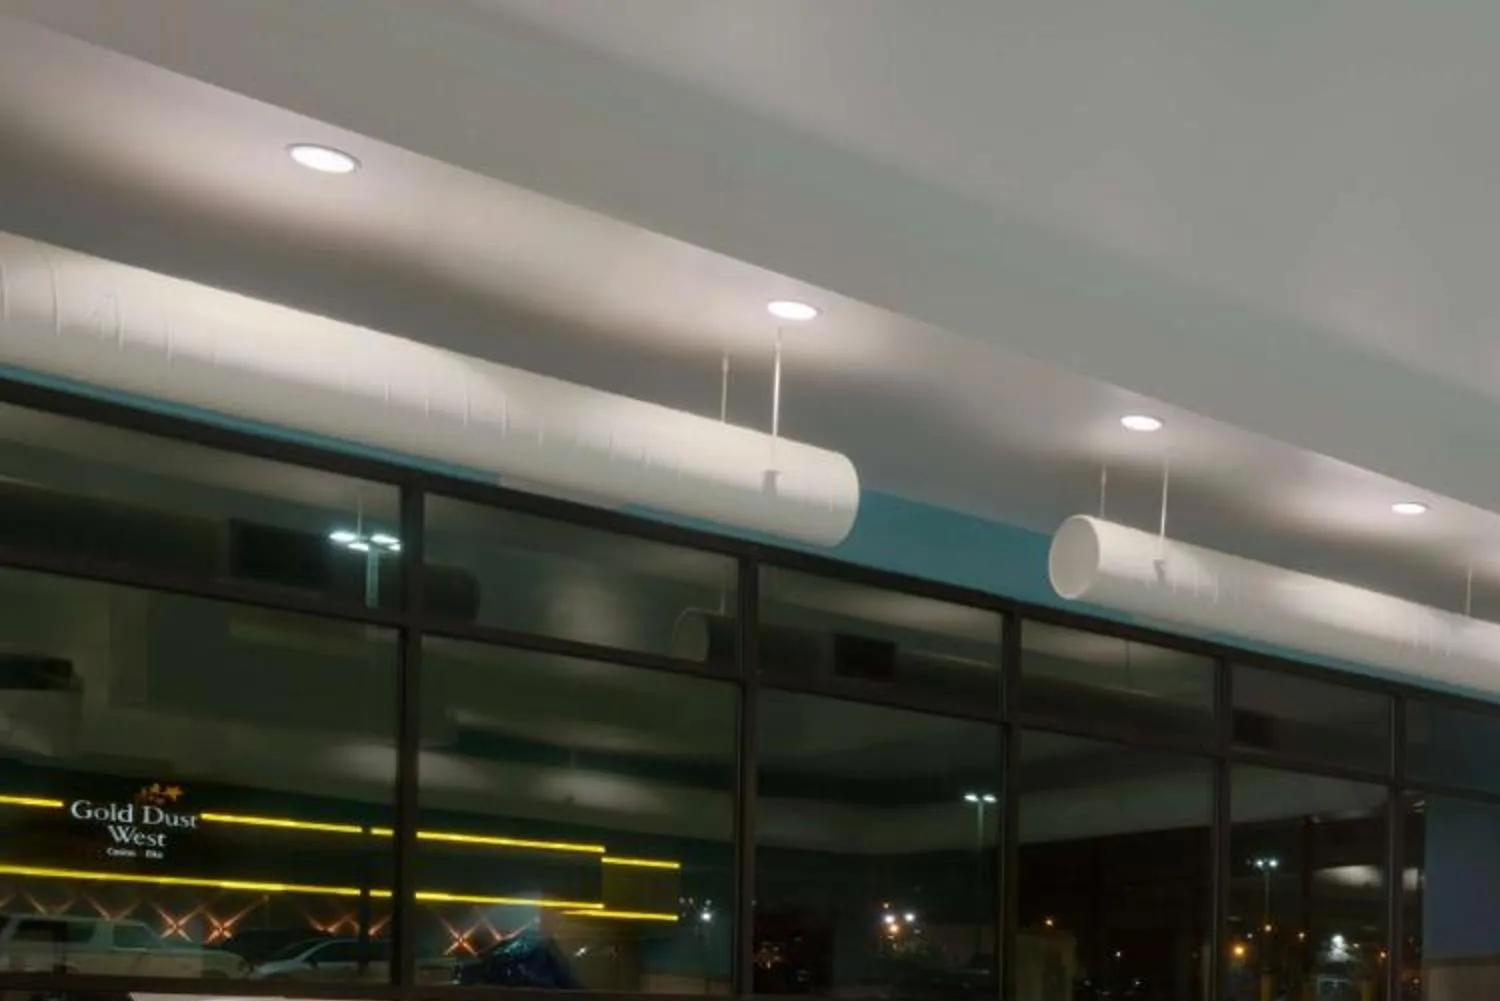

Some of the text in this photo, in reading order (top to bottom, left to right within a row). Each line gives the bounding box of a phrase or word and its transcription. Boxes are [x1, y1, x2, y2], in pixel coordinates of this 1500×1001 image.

[70, 799, 197, 829] Gold Dust
[107, 825, 167, 847] West
